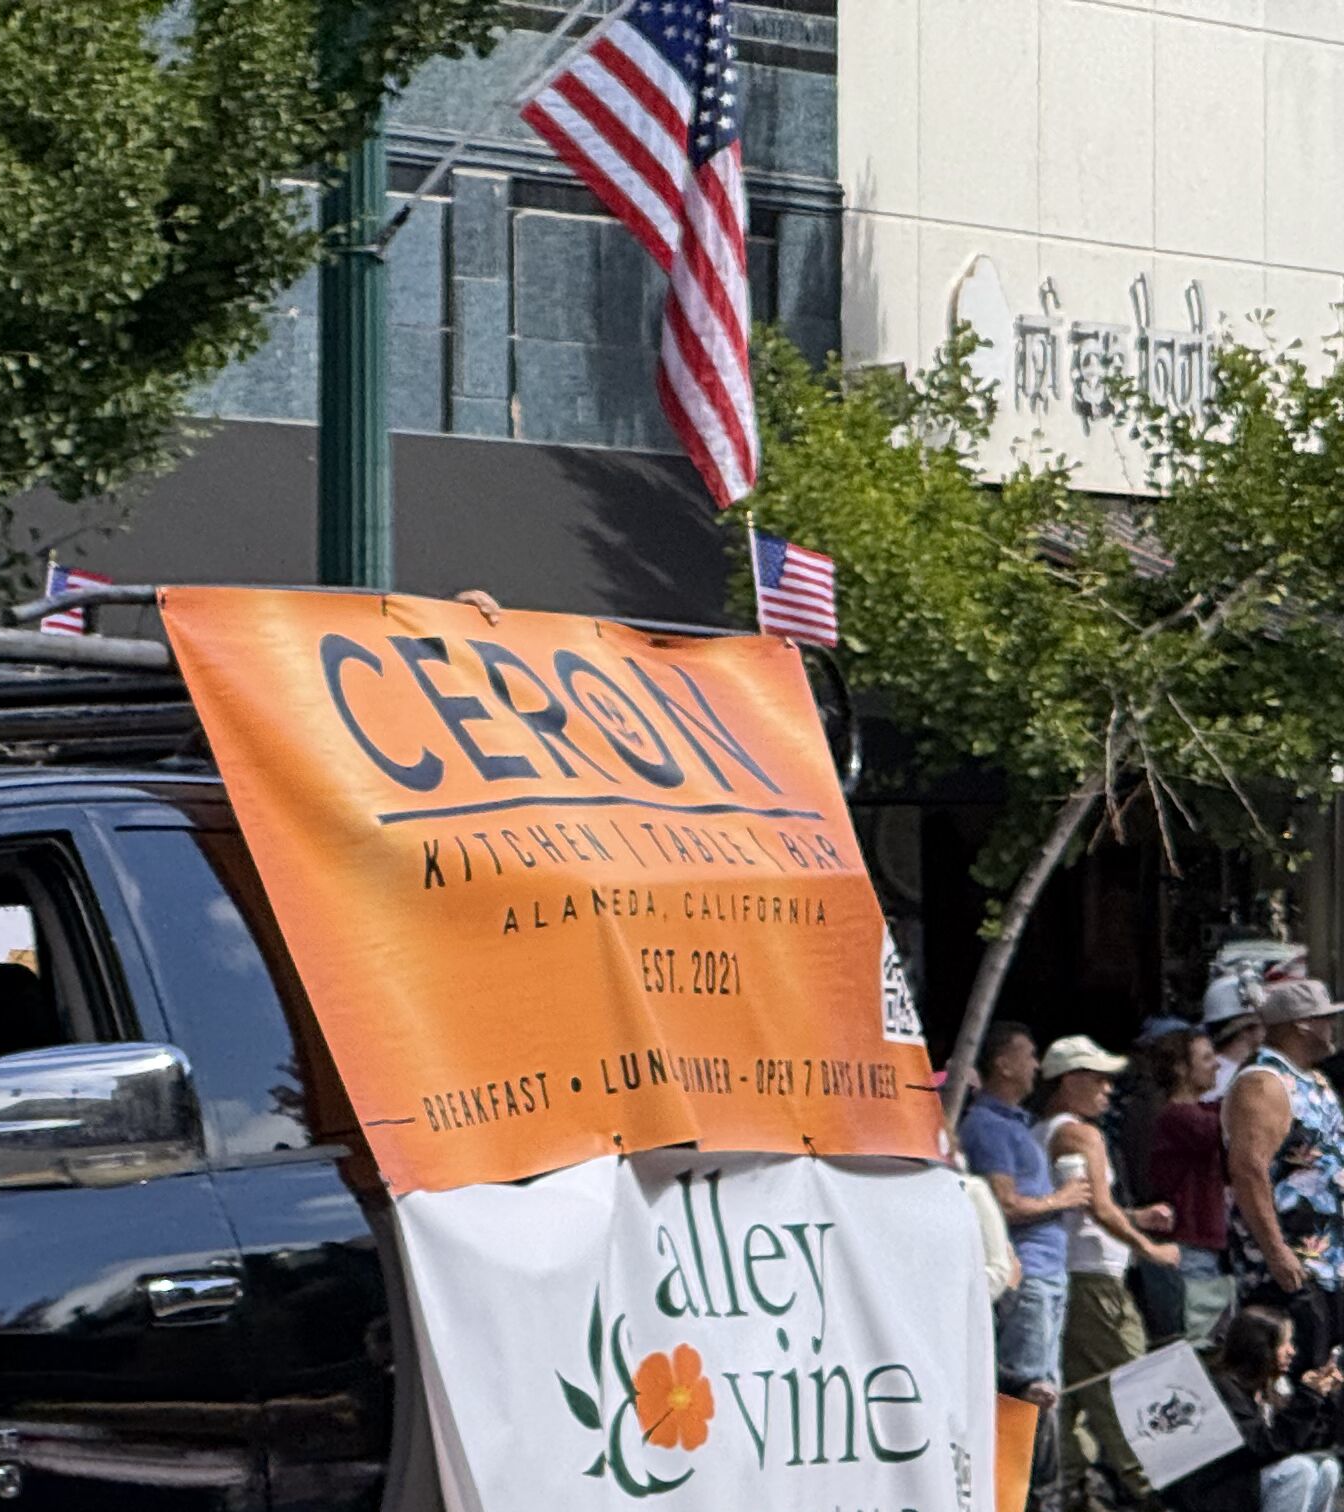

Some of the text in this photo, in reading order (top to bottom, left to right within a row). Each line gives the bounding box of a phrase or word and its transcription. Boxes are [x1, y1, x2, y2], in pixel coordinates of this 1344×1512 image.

[318, 632, 785, 795] CERON
[422, 820, 614, 890] KITCHEN
[640, 821, 756, 866] TABLE
[683, 890, 829, 927] CALIFORNIA
[640, 947, 742, 996] EST. 2021
[421, 1071, 552, 1133] BREAKFAST
[803, 1059, 813, 1097] 7
[654, 1168, 837, 1355] alley
[720, 1326, 931, 1471] vine
